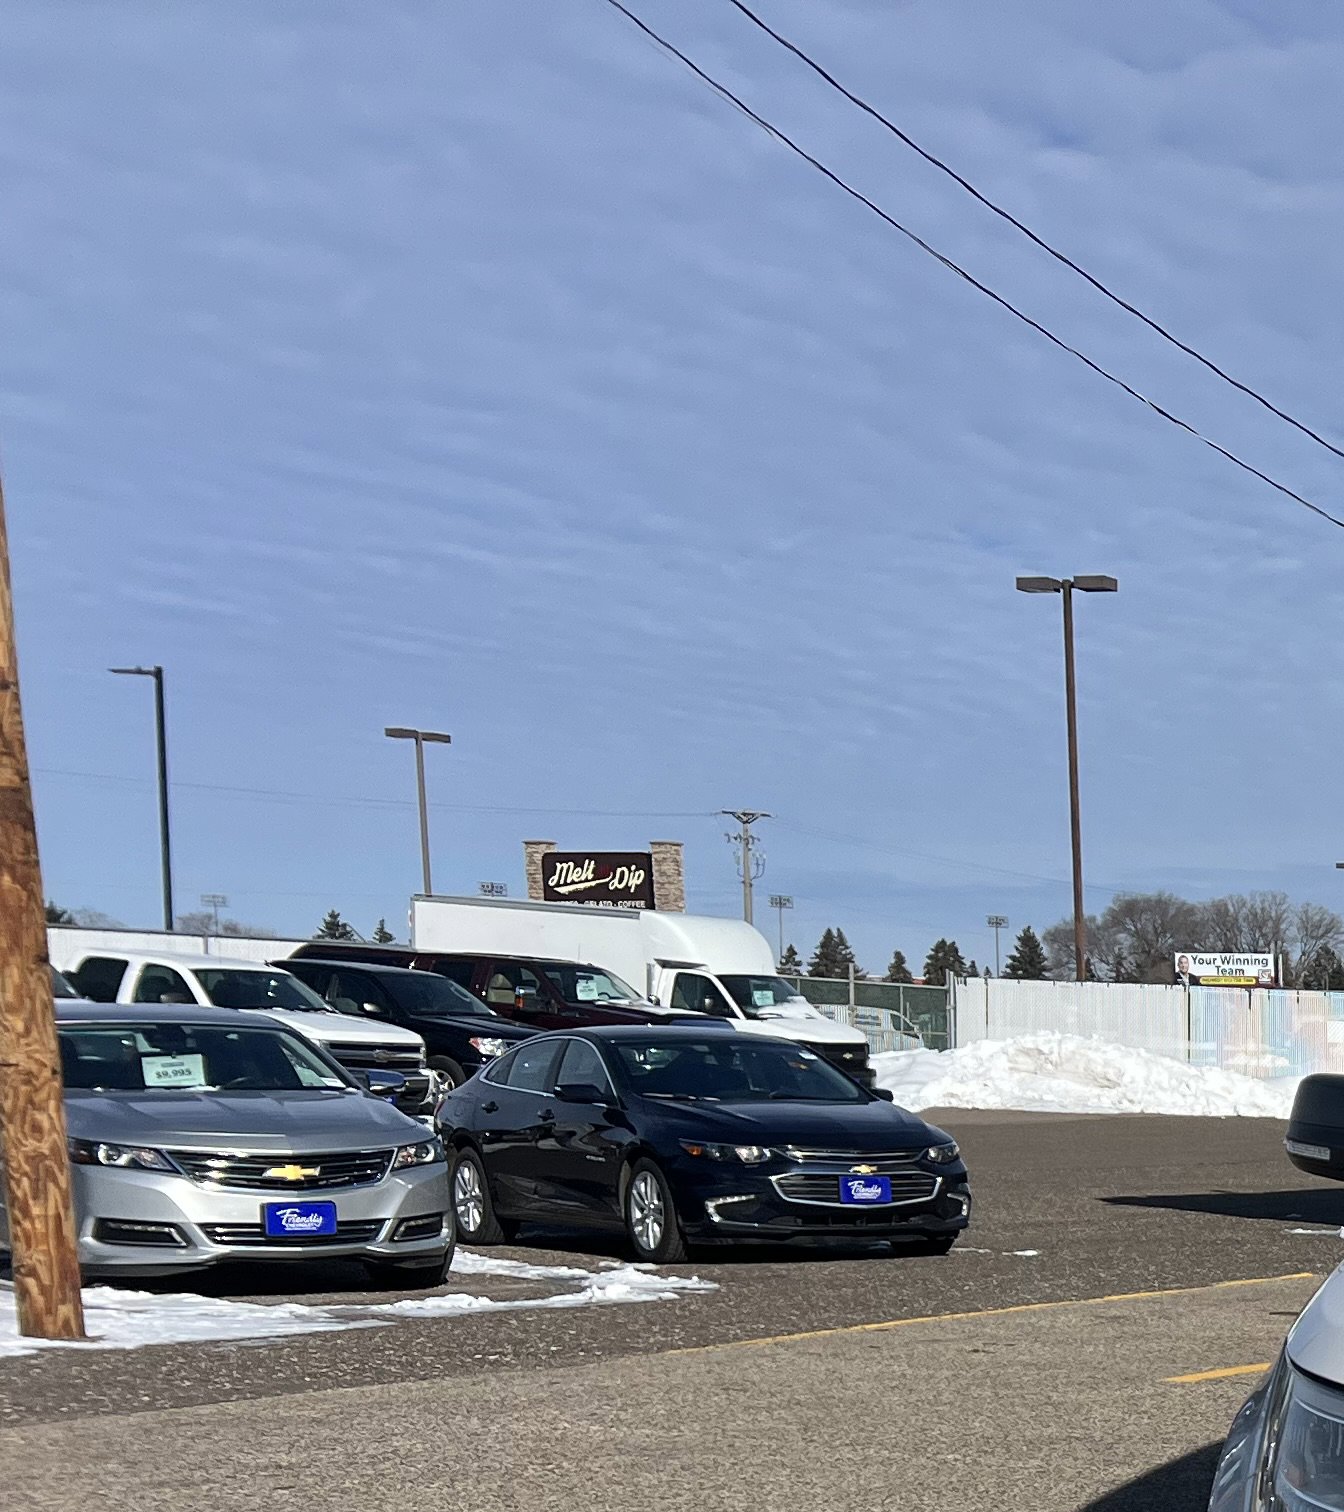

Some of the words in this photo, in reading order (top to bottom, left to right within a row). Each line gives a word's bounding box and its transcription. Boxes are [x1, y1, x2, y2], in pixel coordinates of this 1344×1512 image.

[548, 859, 595, 887] Melt
[608, 864, 645, 893] Dip
[617, 901, 646, 909] COFFEE
[1191, 955, 1218, 965] Your
[1220, 954, 1269, 967] Winning
[1215, 966, 1245, 976] Team
[276, 1208, 323, 1228] Friendly
